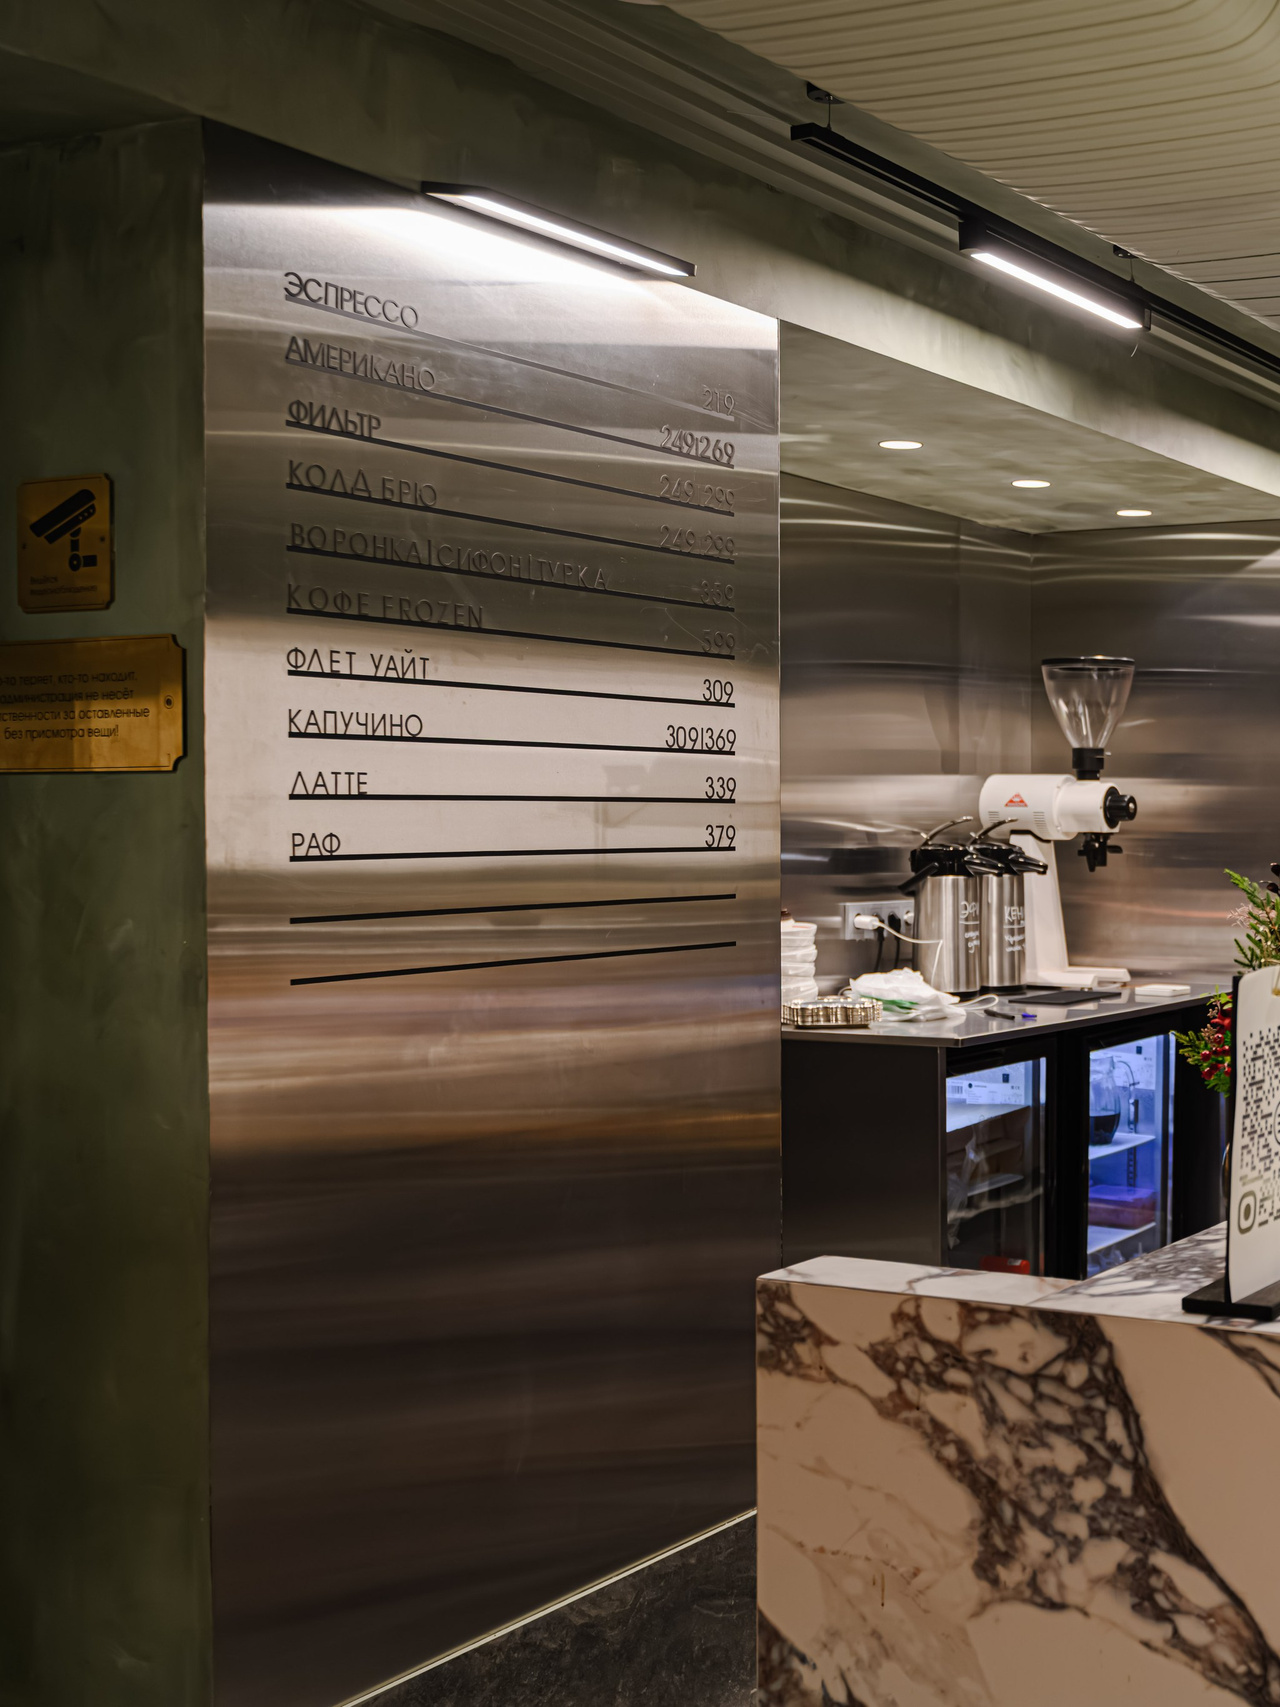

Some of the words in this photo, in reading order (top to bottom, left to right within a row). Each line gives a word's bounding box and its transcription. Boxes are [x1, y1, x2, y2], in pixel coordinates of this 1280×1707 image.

[284, 272, 418, 329] ЭСПРЕССО
[285, 336, 435, 391] АМЕРИКАНО
[702, 386, 735, 416] 219
[288, 400, 381, 438] ФИЛЬТР
[288, 460, 372, 499] КОЛД
[382, 476, 437, 507] БРЮ
[287, 583, 370, 616] КОФЕ
[382, 595, 483, 628] FROZEN
[287, 647, 356, 676] ФЛЕТ
[370, 649, 430, 680] УАЙТ
[58, 673, 89, 685] кто-то
[702, 679, 735, 704] 309
[86, 690, 99, 701] не
[102, 686, 134, 700] несёт
[63, 710, 75, 720] за
[79, 706, 150, 719] оставленные
[288, 709, 423, 738] КАПУЧИНО
[4, 726, 23, 740] без
[25, 728, 85, 742] присмотра
[88, 724, 119, 739] вещи!
[289, 771, 368, 796] ЛАТТЕ
[705, 777, 736, 800] 339
[291, 832, 341, 857] РАФ
[705, 825, 736, 849] 379
